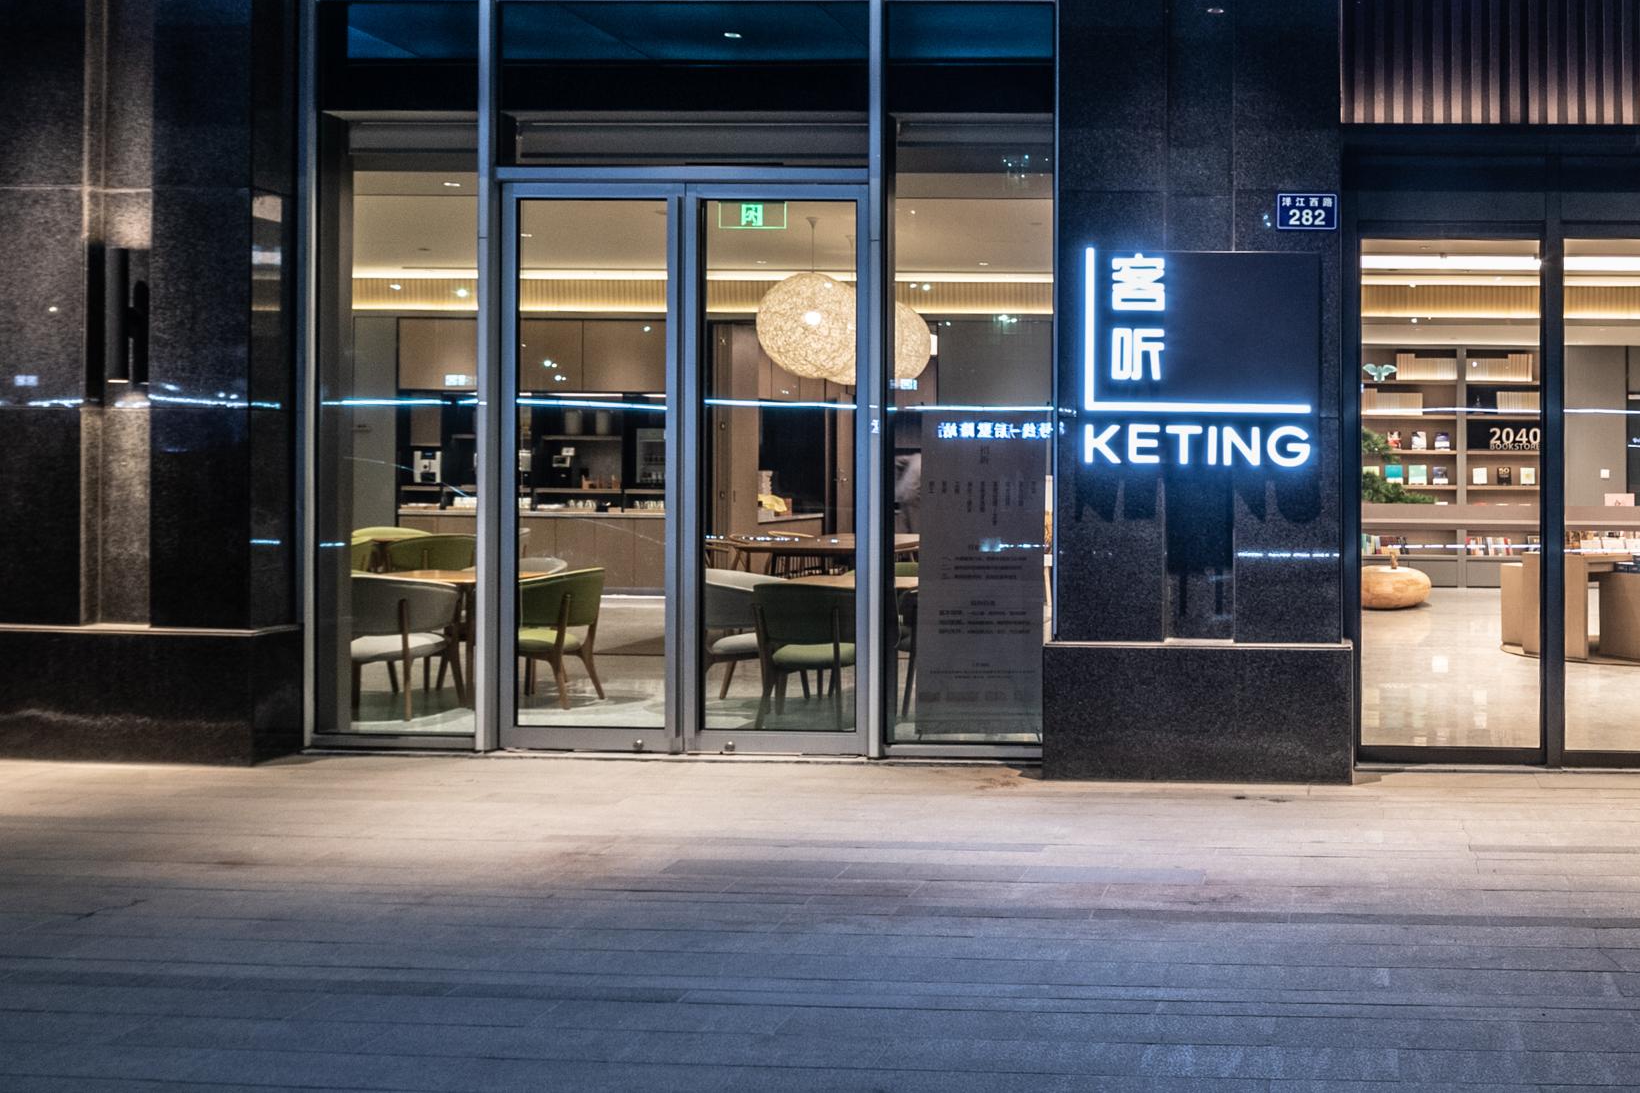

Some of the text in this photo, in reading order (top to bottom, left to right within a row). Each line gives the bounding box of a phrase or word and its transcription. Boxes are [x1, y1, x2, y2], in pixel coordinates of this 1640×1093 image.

[1288, 208, 1326, 226] 282
[1489, 427, 1541, 445] 2040
[1084, 423, 1312, 468] KETING
